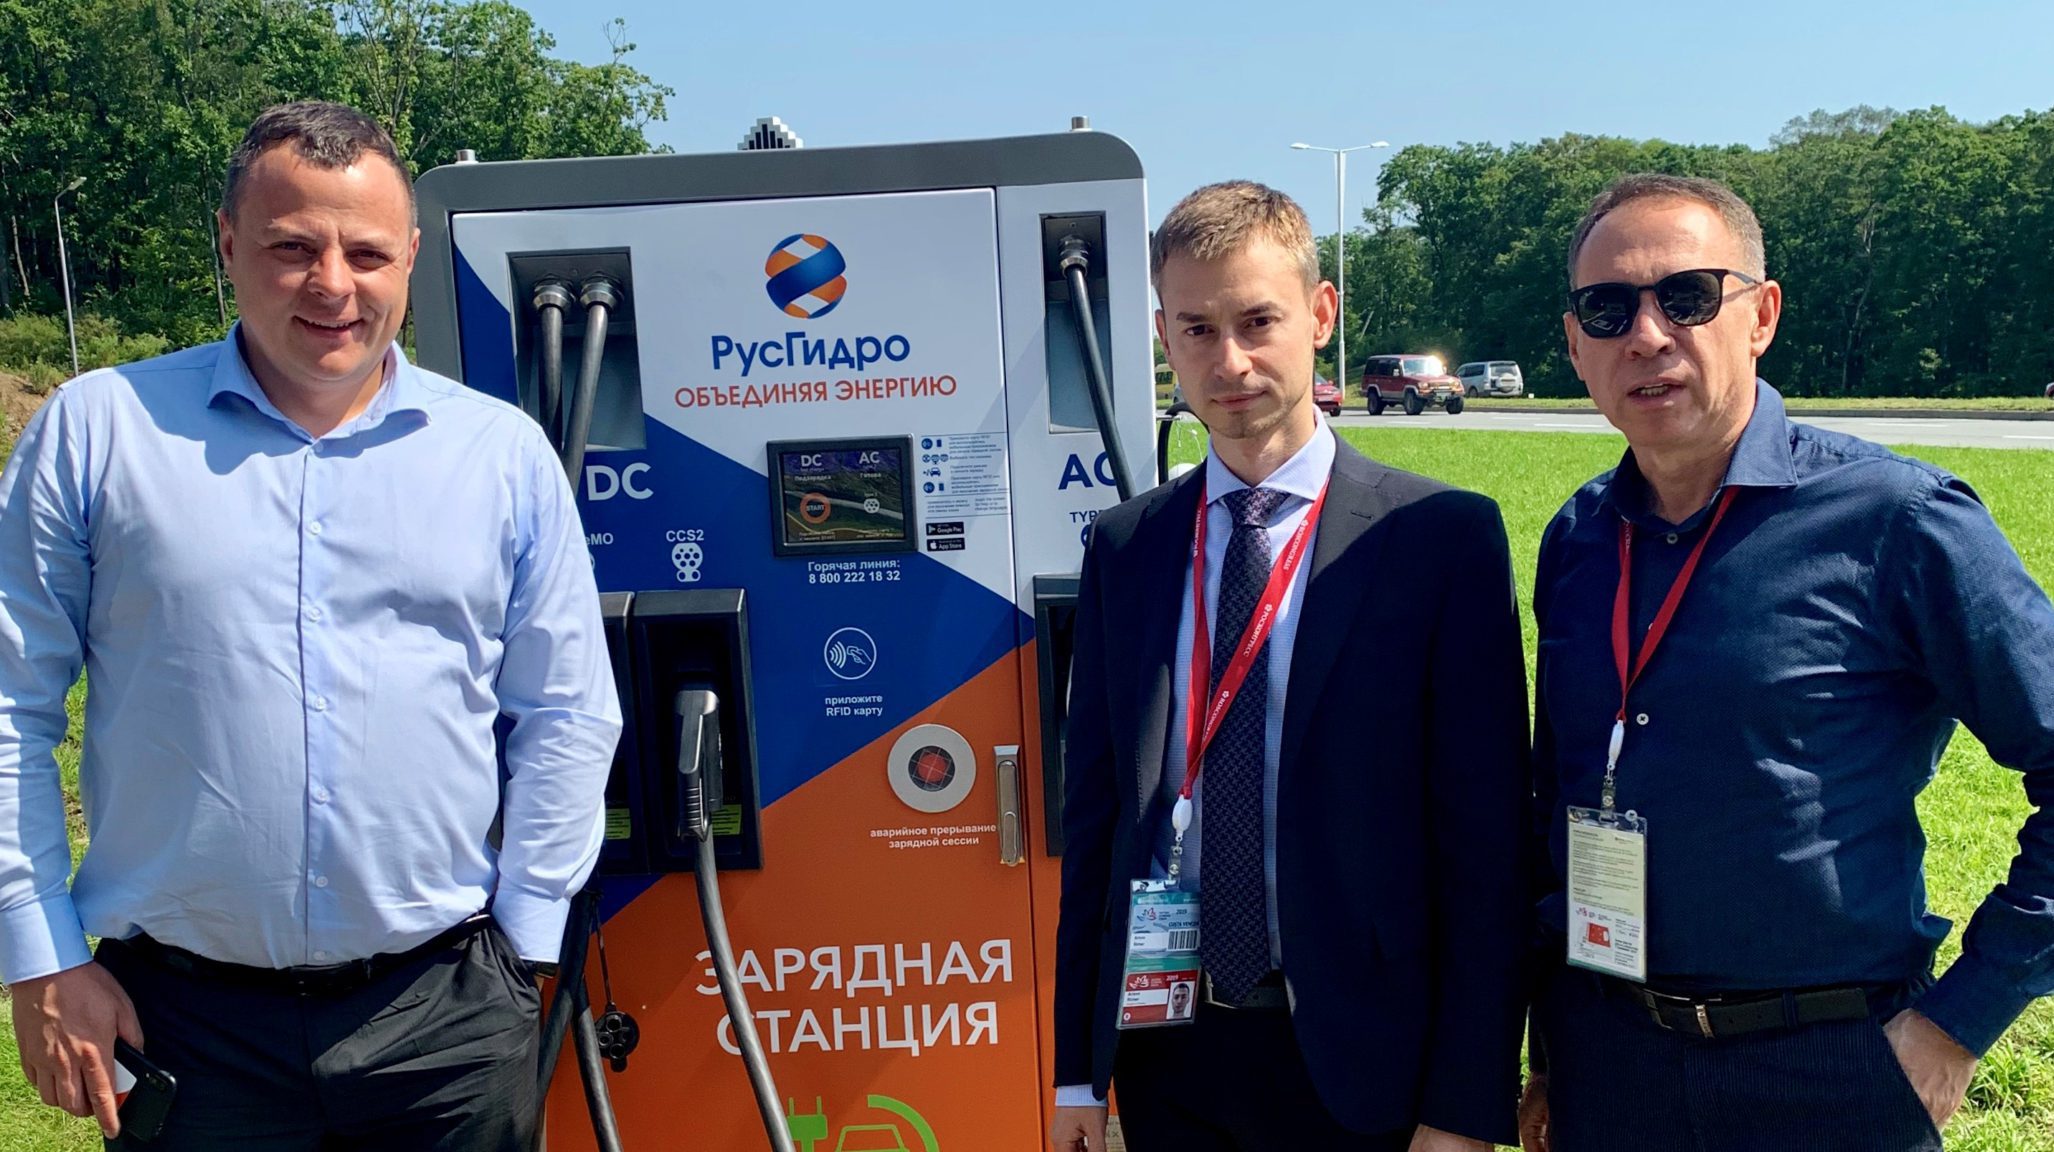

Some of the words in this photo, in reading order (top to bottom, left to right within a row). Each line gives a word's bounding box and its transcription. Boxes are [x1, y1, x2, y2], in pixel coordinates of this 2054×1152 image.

[711, 331, 910, 376] РусГидро
[674, 381, 828, 408] ОБЪЕДИНЯЯ
[834, 375, 957, 401] ЭНЕРГИЮ
[800, 454, 822, 467] DC
[859, 451, 880, 464] AC
[1058, 450, 1118, 490] AC
[586, 462, 654, 500] DC
[1069, 510, 1103, 523] TYP
[665, 529, 705, 542] CCS2
[808, 562, 857, 572] Горячая
[860, 560, 901, 570] линия:
[809, 574, 816, 584] 8
[819, 573, 841, 583] 800
[844, 572, 866, 582] 222
[869, 571, 883, 581] 18
[886, 571, 901, 581] 32
[825, 695, 883, 705] приложите
[826, 707, 851, 716] RFID
[854, 706, 883, 716] карту
[870, 826, 928, 838] аварийное
[930, 824, 997, 836] прерывание
[889, 838, 940, 850] зарядной
[942, 837, 979, 846] сессии
[695, 939, 1013, 998] ЗАРЯДНАЯ
[716, 1001, 999, 1057] СТАНЦИЯ
